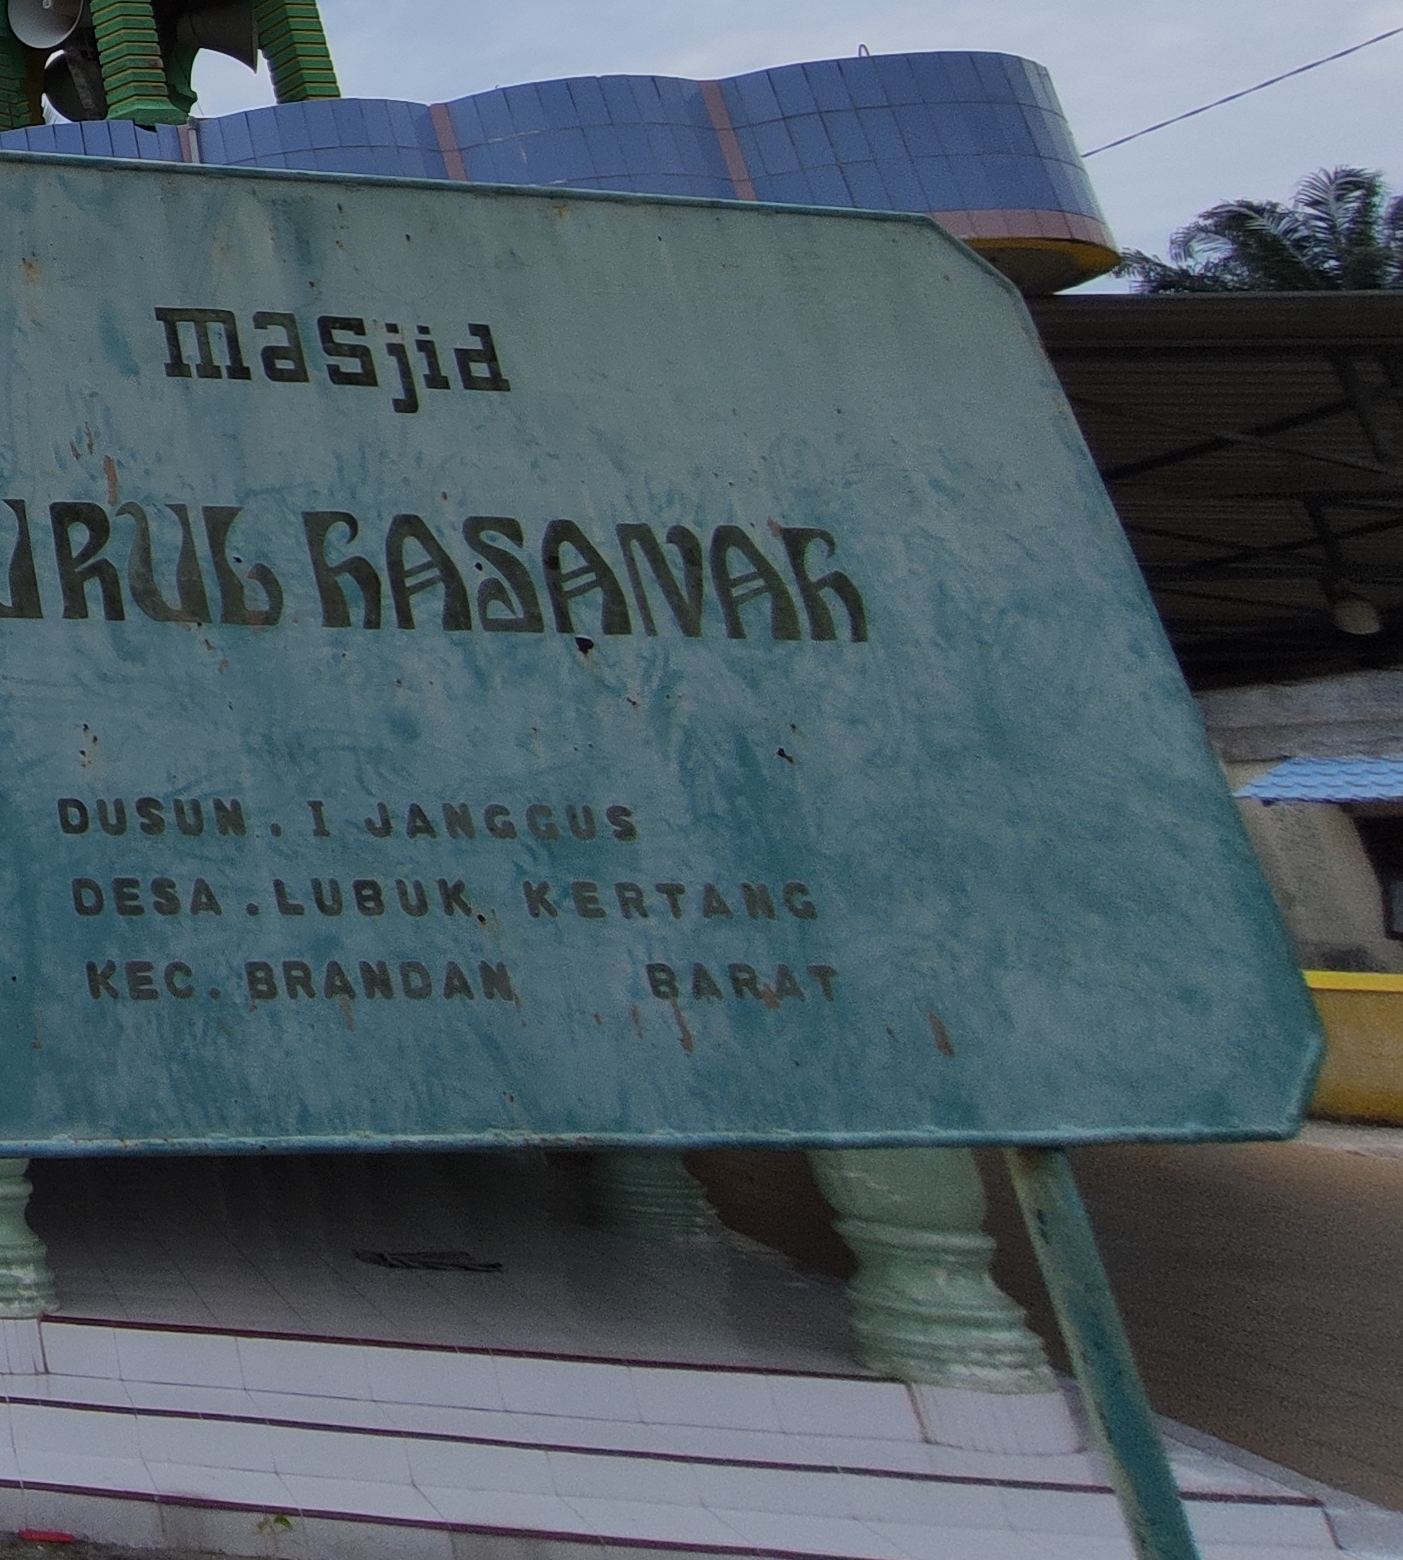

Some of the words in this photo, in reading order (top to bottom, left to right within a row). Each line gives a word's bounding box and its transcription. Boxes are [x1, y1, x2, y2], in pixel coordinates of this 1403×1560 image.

[154, 306, 511, 414] masjid
[363, 801, 638, 841] JANGGUS
[521, 880, 819, 920] KERTANG
[244, 959, 516, 1003] BRANDAN
[645, 961, 838, 1003] BARAT
